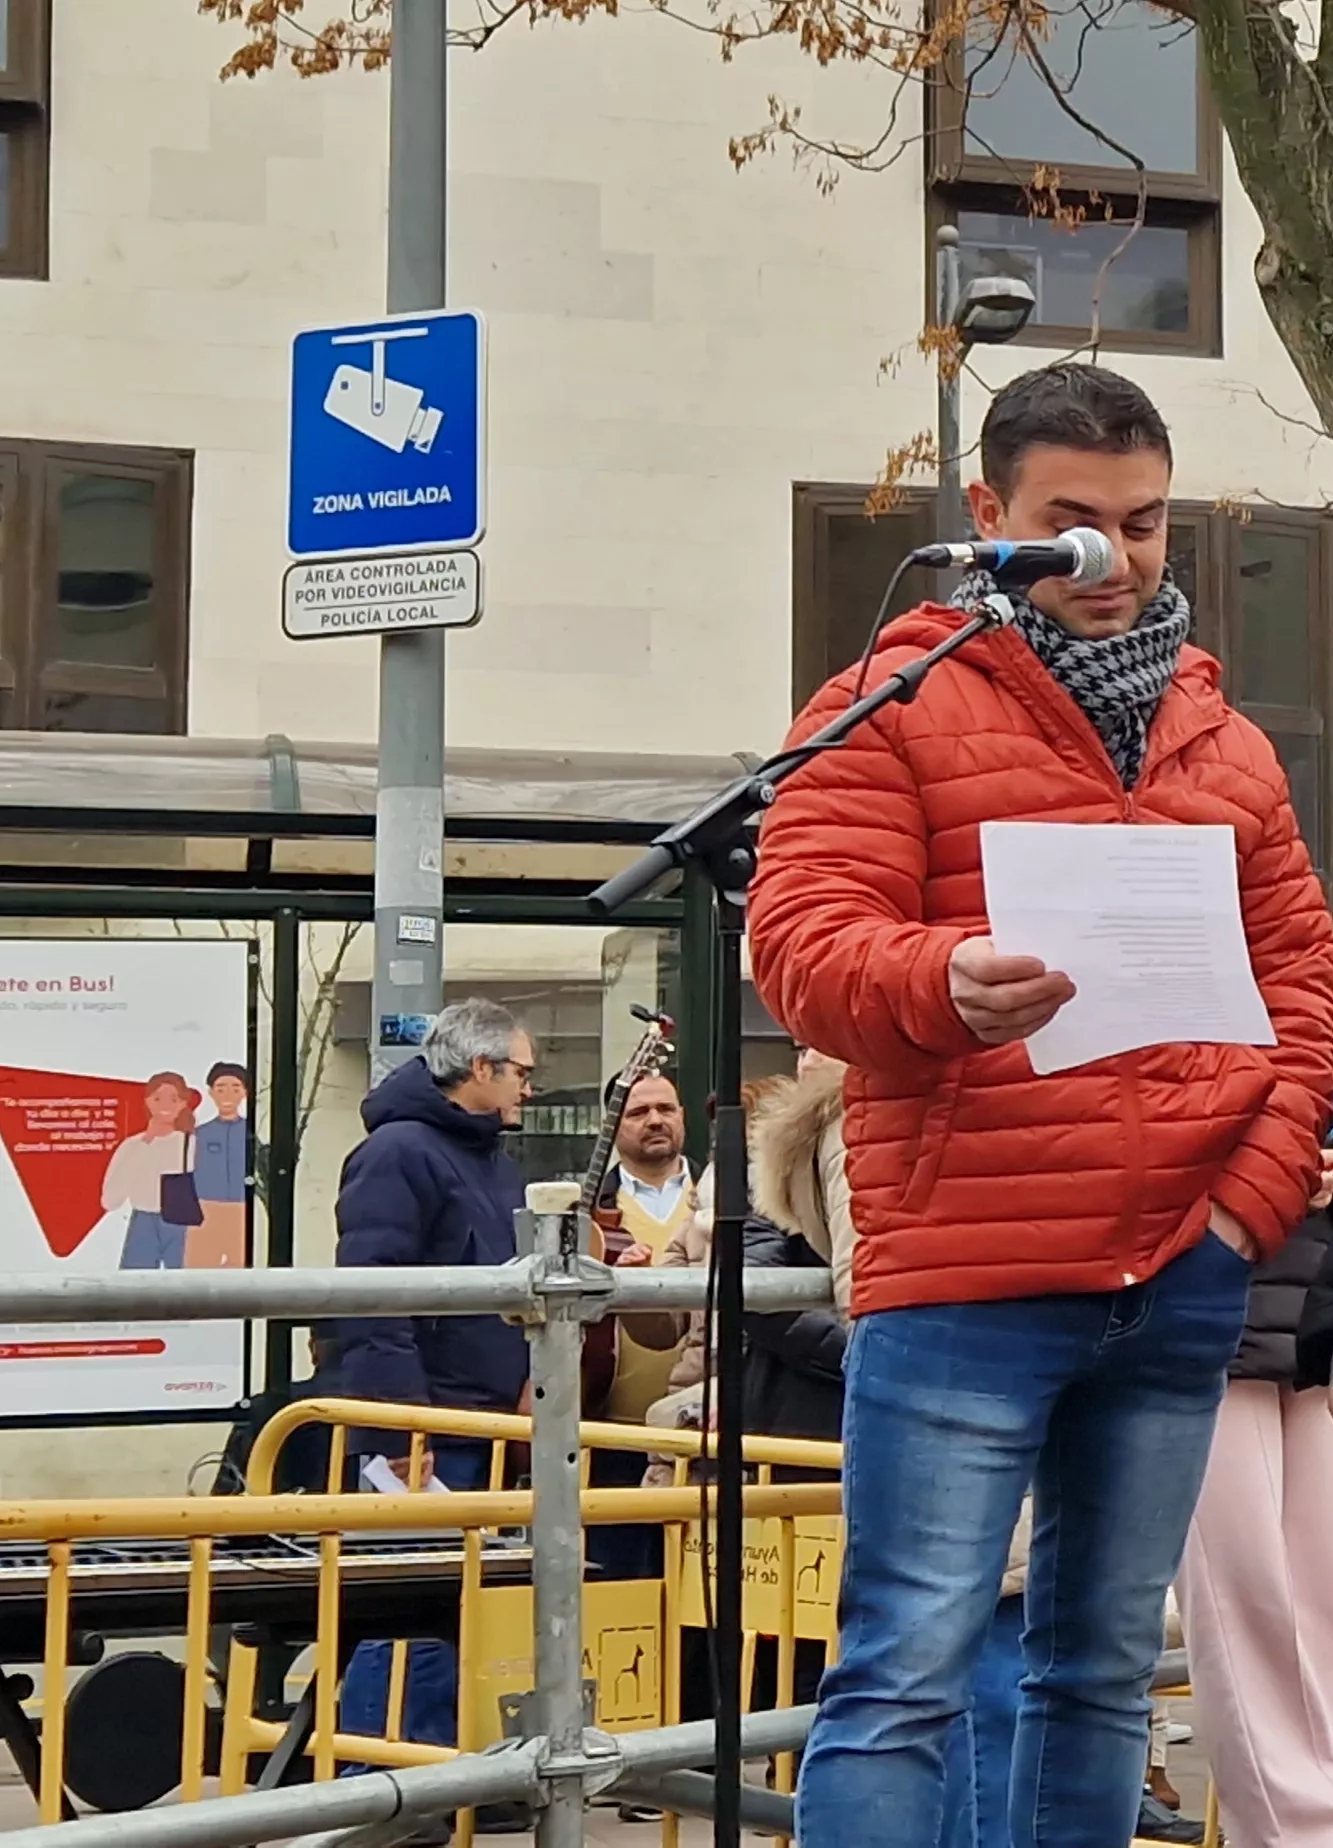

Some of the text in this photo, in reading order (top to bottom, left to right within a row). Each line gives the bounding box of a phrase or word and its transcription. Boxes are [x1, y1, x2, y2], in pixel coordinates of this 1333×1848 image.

[313, 485, 452, 514] ZONA VIGILADA
[304, 559, 457, 584] ÁREA CONTROLADA
[295, 576, 466, 604] POR VIDEOVIGILANCIA
[321, 604, 438, 628] POLICÍA LOCAL
[36, 980, 62, 992] en
[70, 975, 114, 992] Bus!
